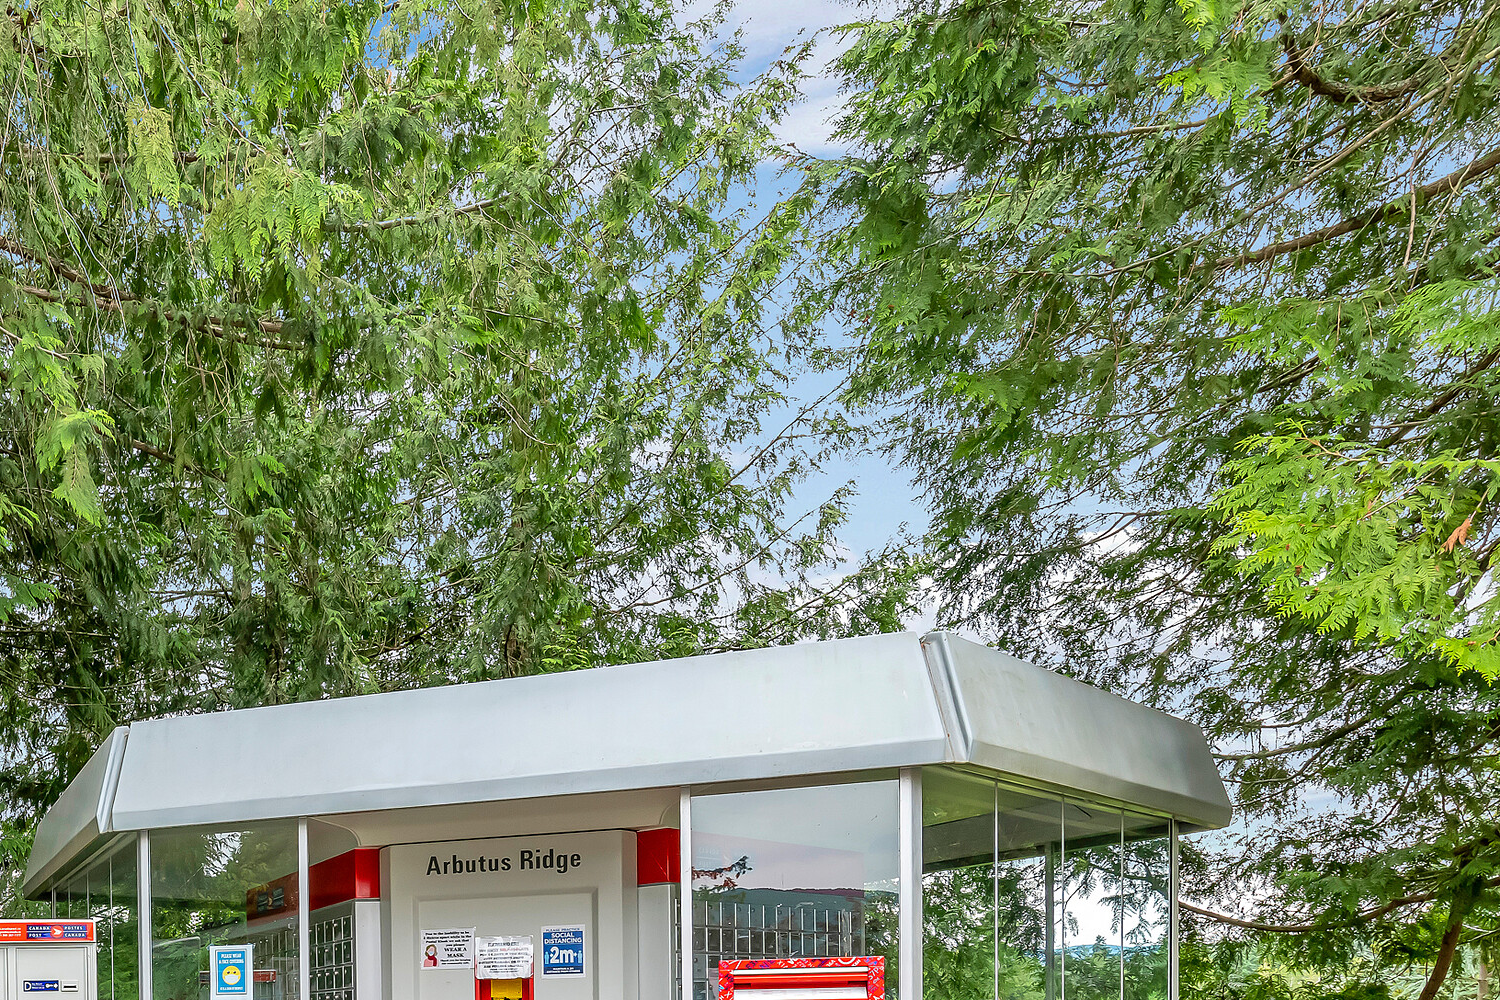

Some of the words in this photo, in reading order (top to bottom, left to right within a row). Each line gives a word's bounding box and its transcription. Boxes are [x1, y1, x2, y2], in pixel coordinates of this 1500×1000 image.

[426, 854, 512, 876] Arbutus
[520, 848, 581, 874] Ridge
[544, 937, 582, 945] DISTANCING
[550, 946, 574, 964] 2m
[24, 981, 32, 991] D
